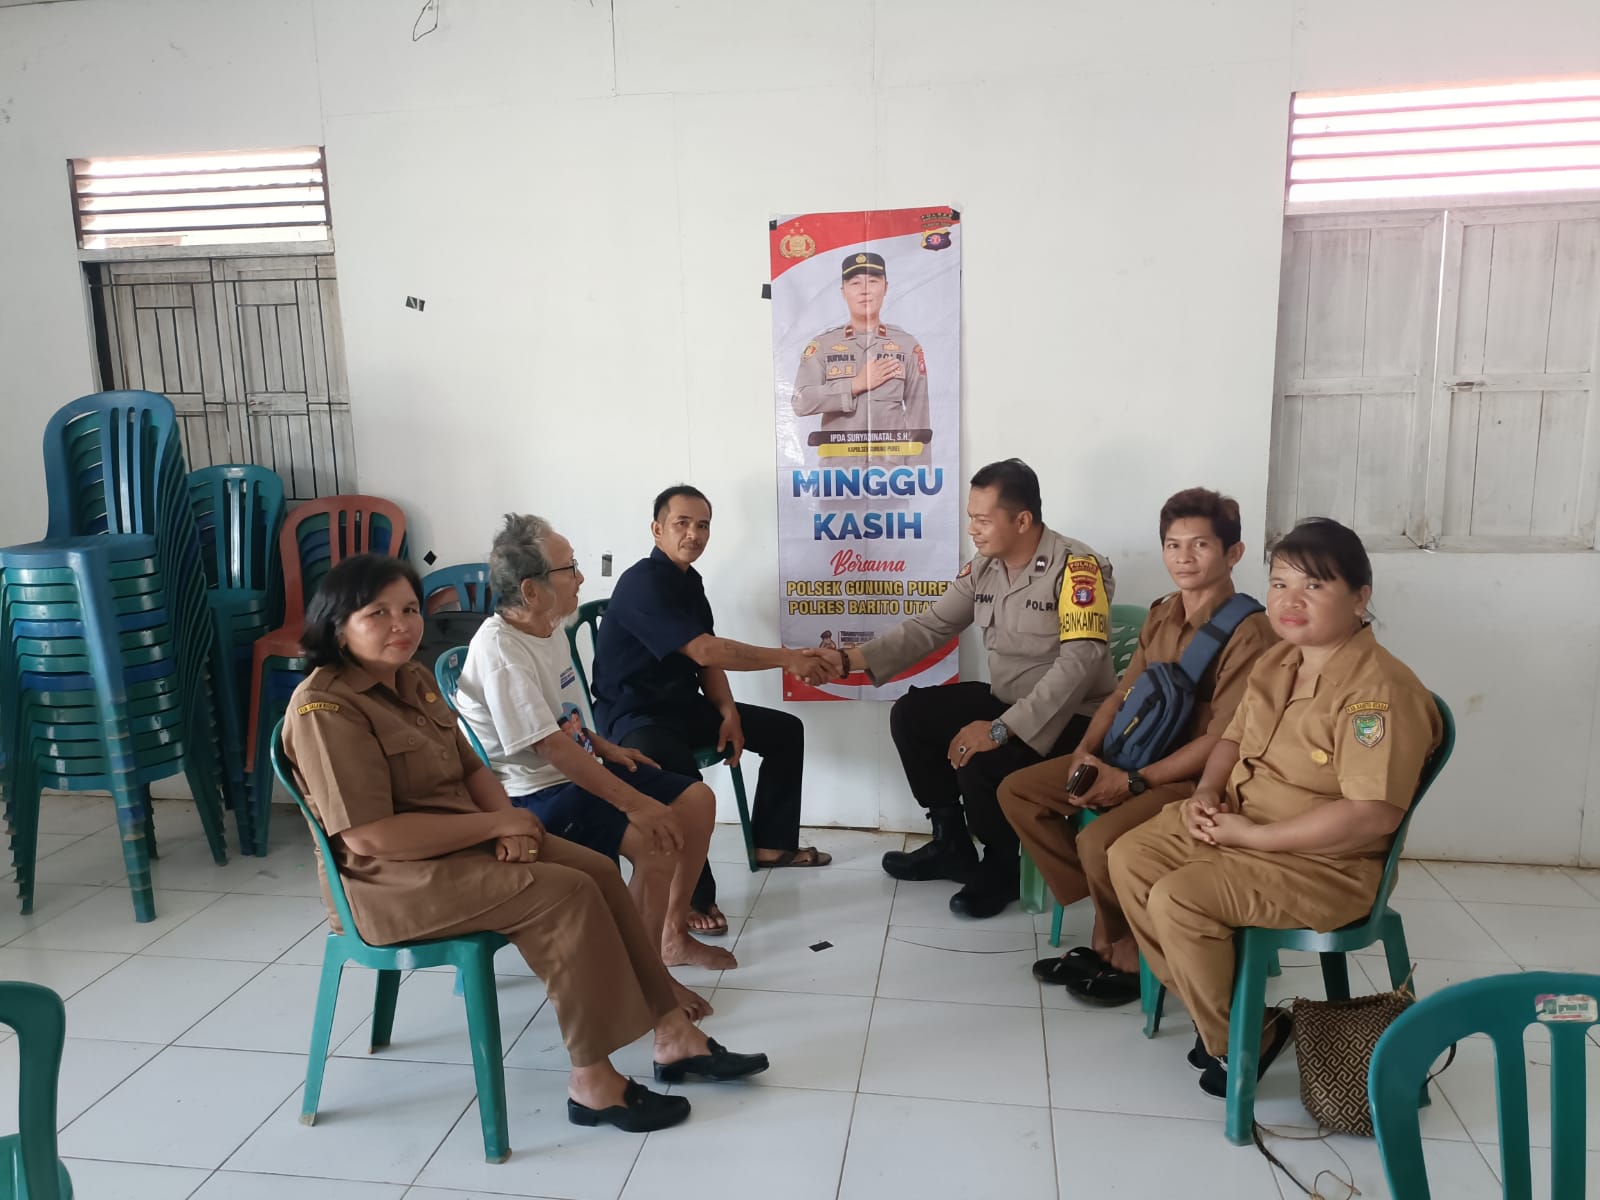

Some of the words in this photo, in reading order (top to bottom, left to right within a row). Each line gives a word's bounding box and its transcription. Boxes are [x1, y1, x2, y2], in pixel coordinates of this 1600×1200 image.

[830, 433, 846, 442] IPDA
[793, 468, 942, 497] MINGGU
[813, 512, 922, 541] KASIH
[830, 549, 907, 577] Bersama
[786, 580, 842, 597] POLSEK
[844, 580, 904, 596] GUNUNG
[788, 600, 845, 615] POLRES
[847, 600, 900, 615] BARITO
